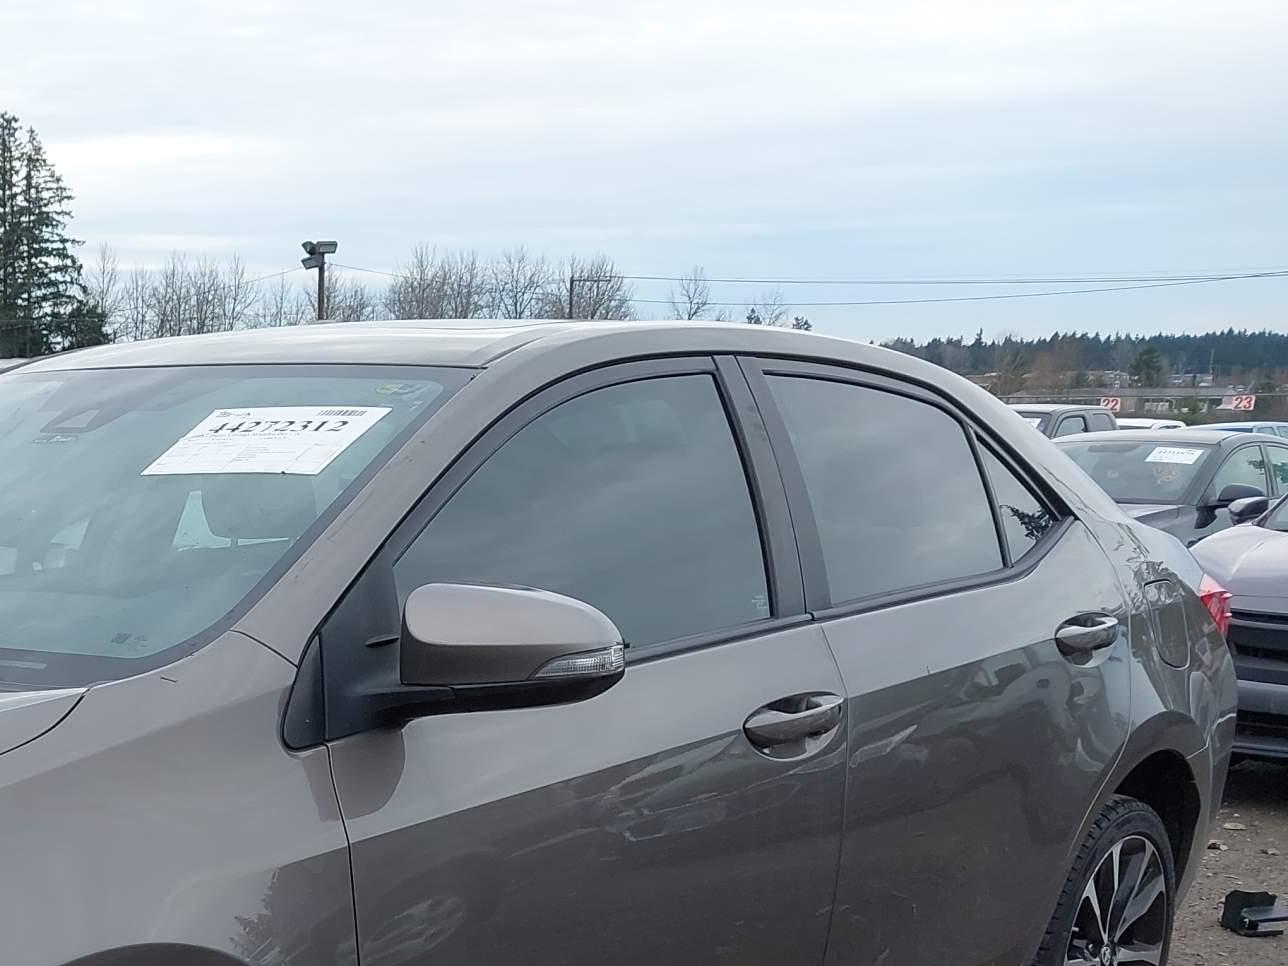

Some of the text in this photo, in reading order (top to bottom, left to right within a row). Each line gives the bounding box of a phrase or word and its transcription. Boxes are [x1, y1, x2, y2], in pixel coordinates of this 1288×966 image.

[1102, 398, 1119, 411] 22
[1233, 396, 1253, 410] 23
[209, 420, 349, 434] 44272312
